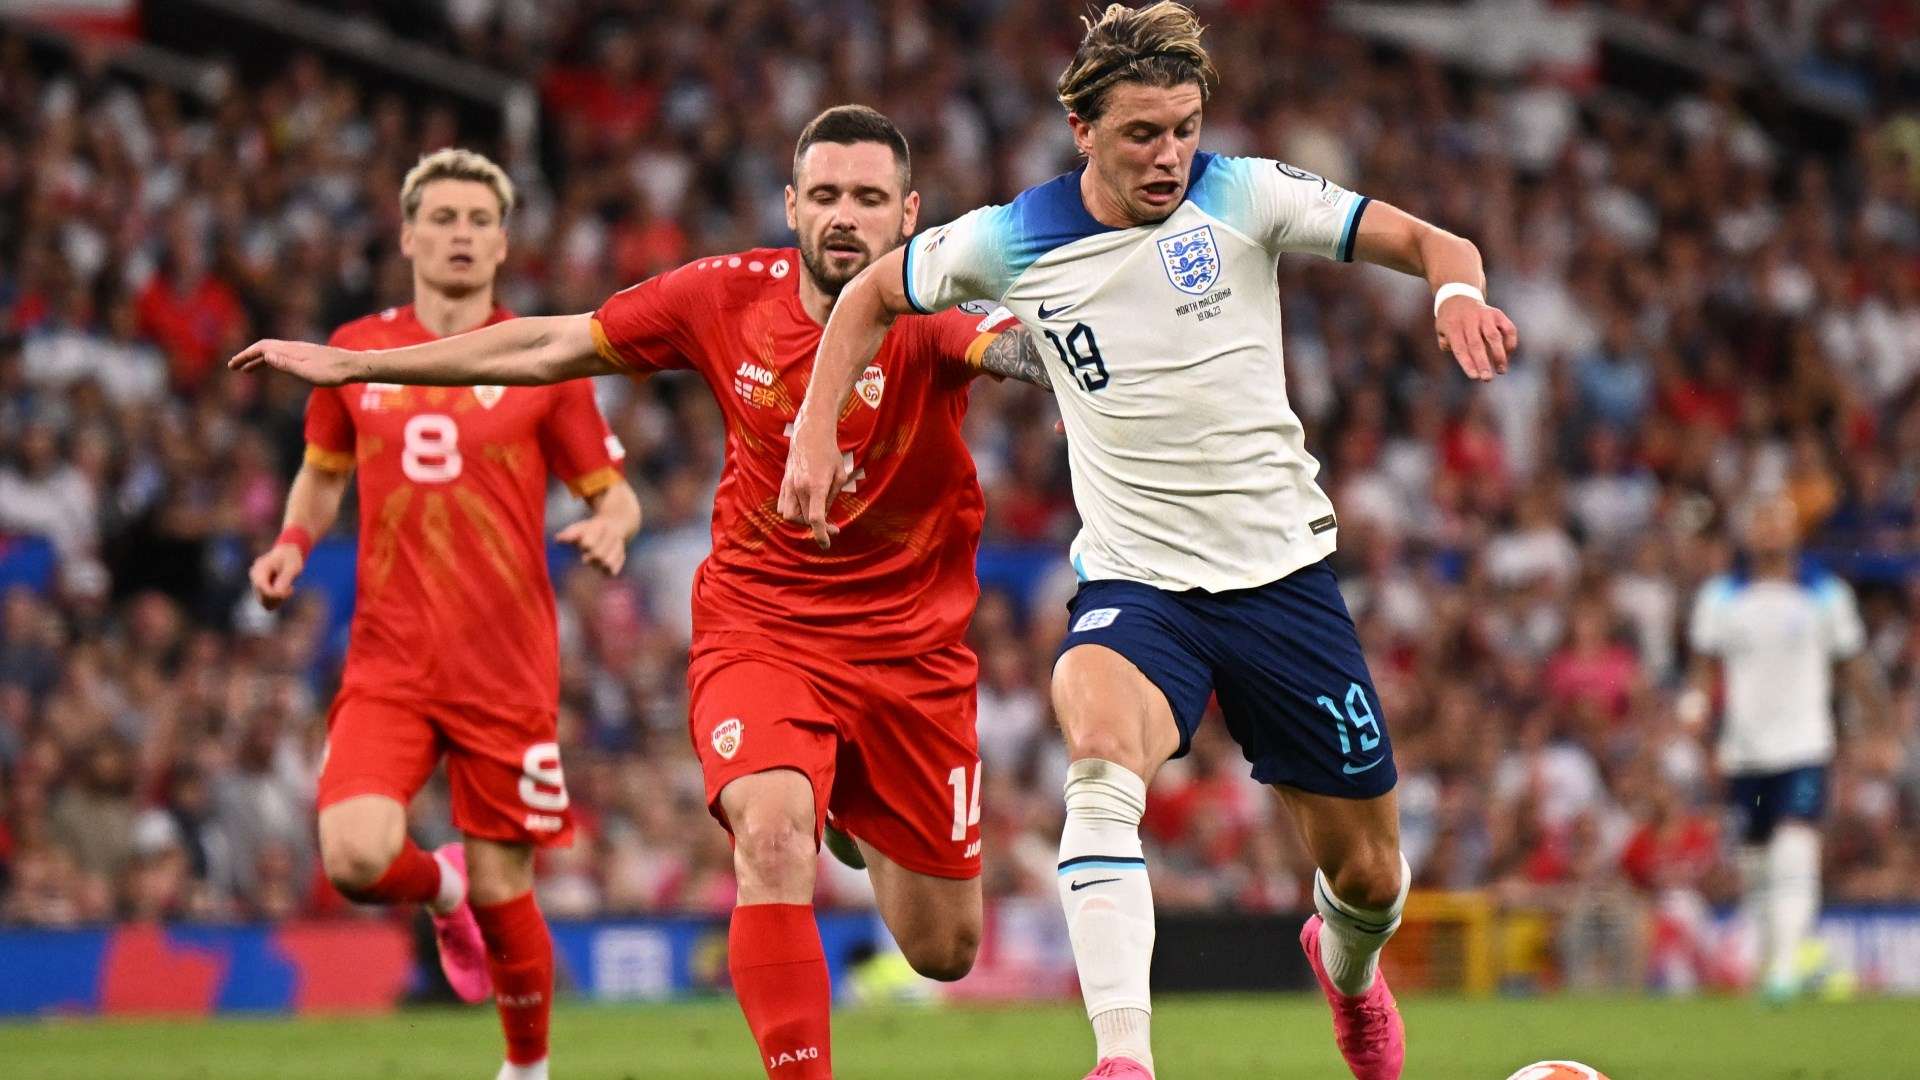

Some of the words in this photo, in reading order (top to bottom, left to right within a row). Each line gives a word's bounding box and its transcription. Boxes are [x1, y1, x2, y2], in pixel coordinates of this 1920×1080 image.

[1175, 302, 1198, 317] NORTH
[1198, 287, 1233, 308] MACEDONIA
[736, 361, 773, 386] JAKO
[1043, 322, 1110, 392] 19
[402, 414, 463, 483] 8
[1316, 682, 1380, 754] 19
[769, 1046, 818, 1069] JAKO
